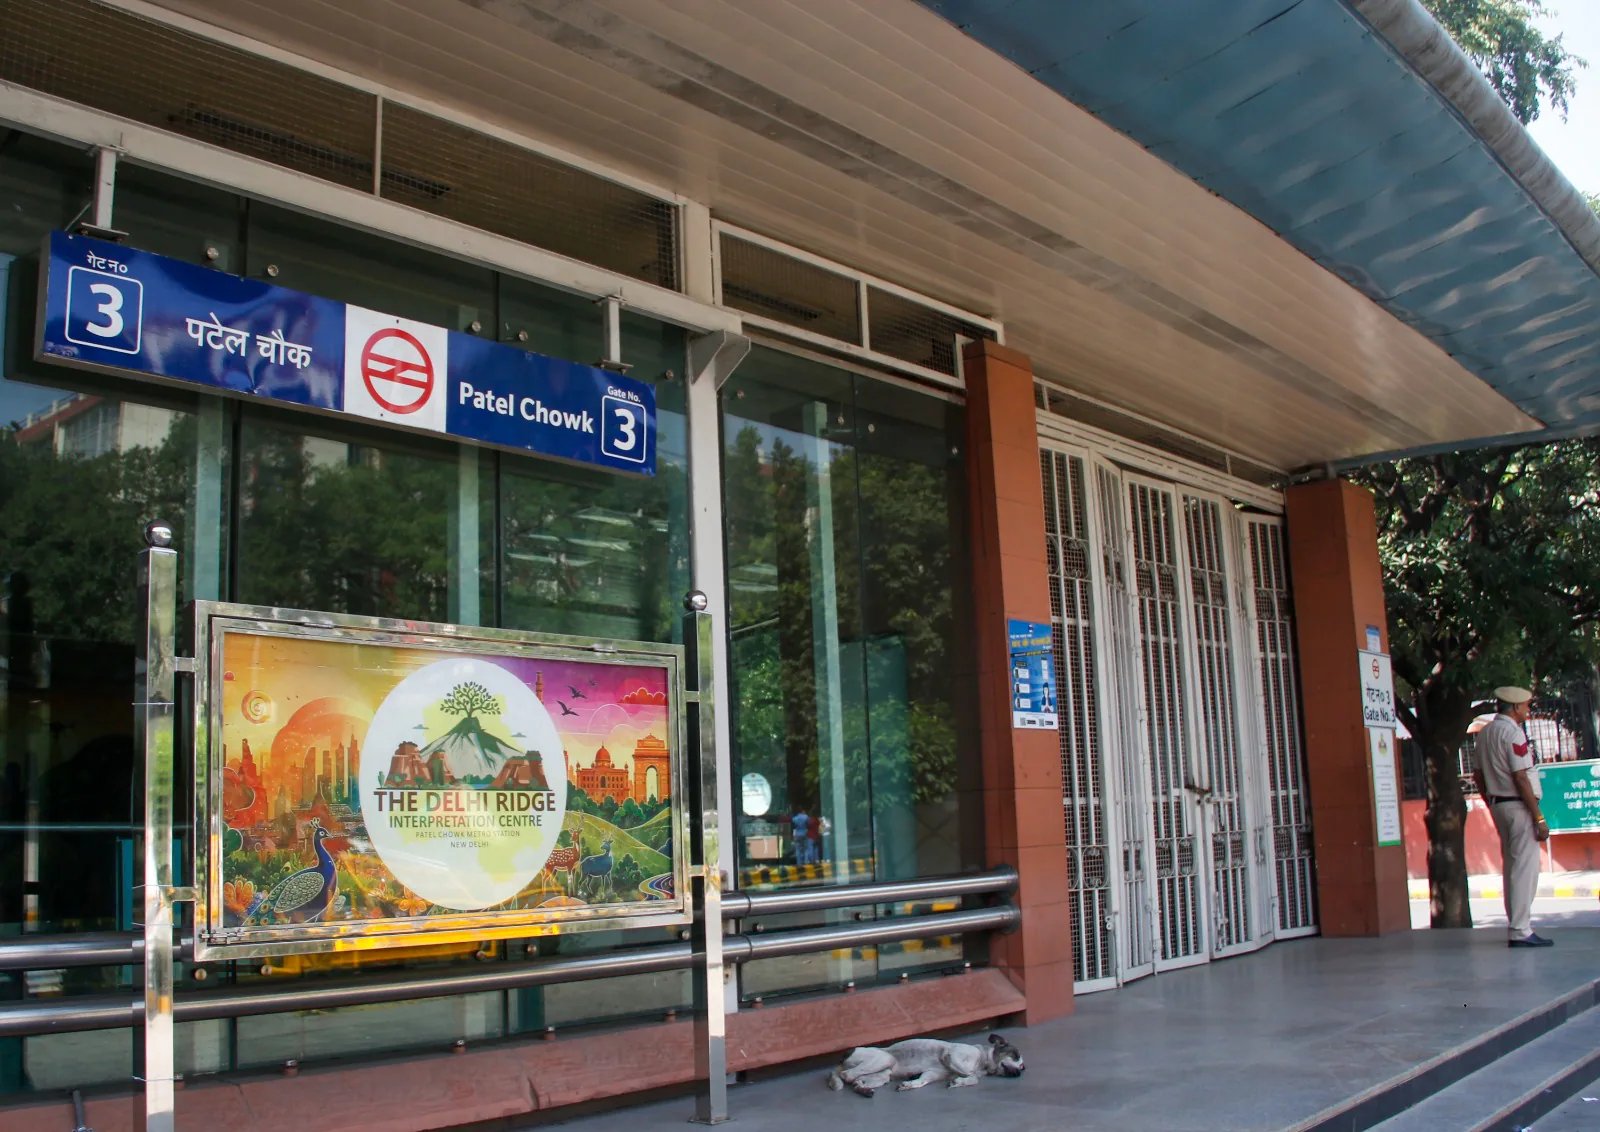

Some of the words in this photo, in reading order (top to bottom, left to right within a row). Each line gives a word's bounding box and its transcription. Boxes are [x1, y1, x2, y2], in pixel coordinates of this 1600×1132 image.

[86, 250, 106, 270] गेट
[86, 283, 124, 338] 3
[185, 311, 250, 357] पटेल
[256, 328, 313, 369] चौक
[607, 385, 626, 399] Gate
[627, 391, 641, 403] No.
[459, 381, 514, 417] Patel
[519, 397, 594, 434] Chowk
[613, 408, 636, 451] 3
[1364, 705, 1380, 721] Gate
[1380, 707, 1390, 722] No.
[1391, 708, 1396, 722] 3
[373, 791, 418, 812] THE
[426, 791, 488, 812] DELHI
[496, 792, 556, 812] RIDGE
[389, 815, 495, 828] INTERPRETATION
[498, 814, 543, 827] CENTRE
[438, 830, 464, 838] CHOWK
[466, 830, 491, 838] METRO
